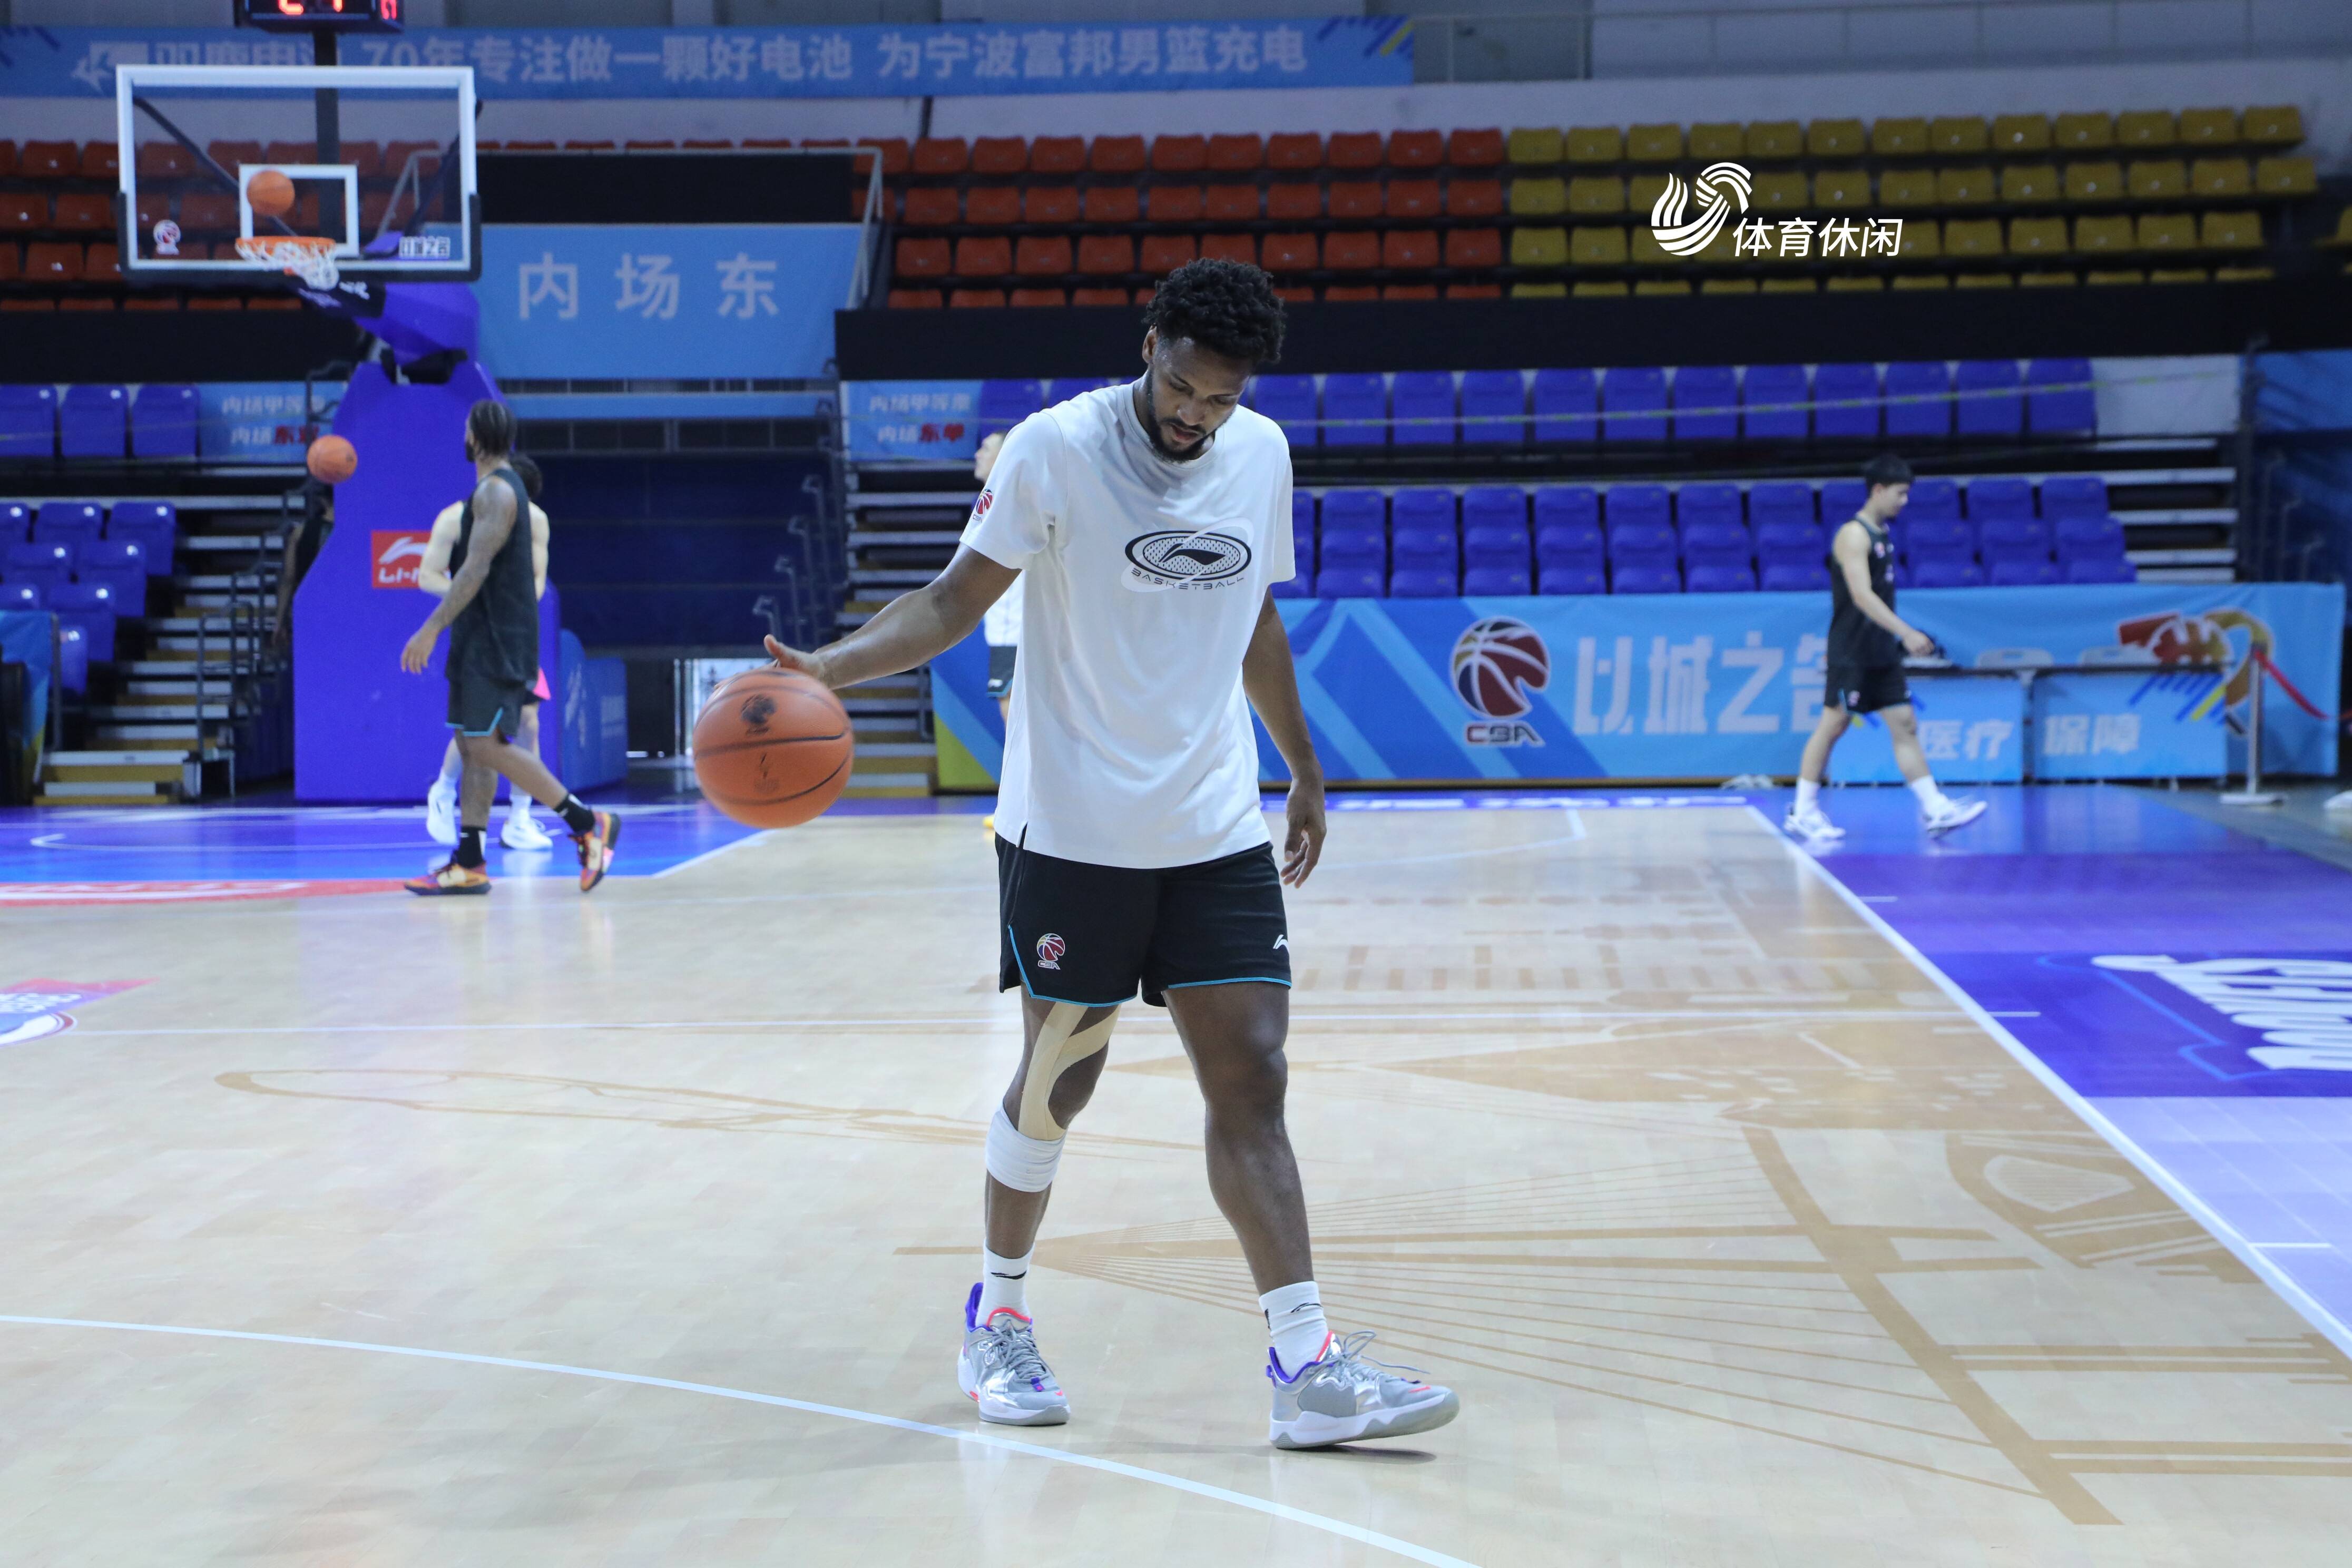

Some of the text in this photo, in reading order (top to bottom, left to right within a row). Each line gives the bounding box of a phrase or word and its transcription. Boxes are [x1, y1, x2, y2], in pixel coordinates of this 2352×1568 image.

[877, 28, 1308, 79] 为宁波富邦男篮充电
[519, 252, 779, 319] 内场东
[1131, 567, 1244, 590] BASKETBALL
[1465, 721, 1545, 748] CBA
[1038, 959, 1061, 970] CBA
